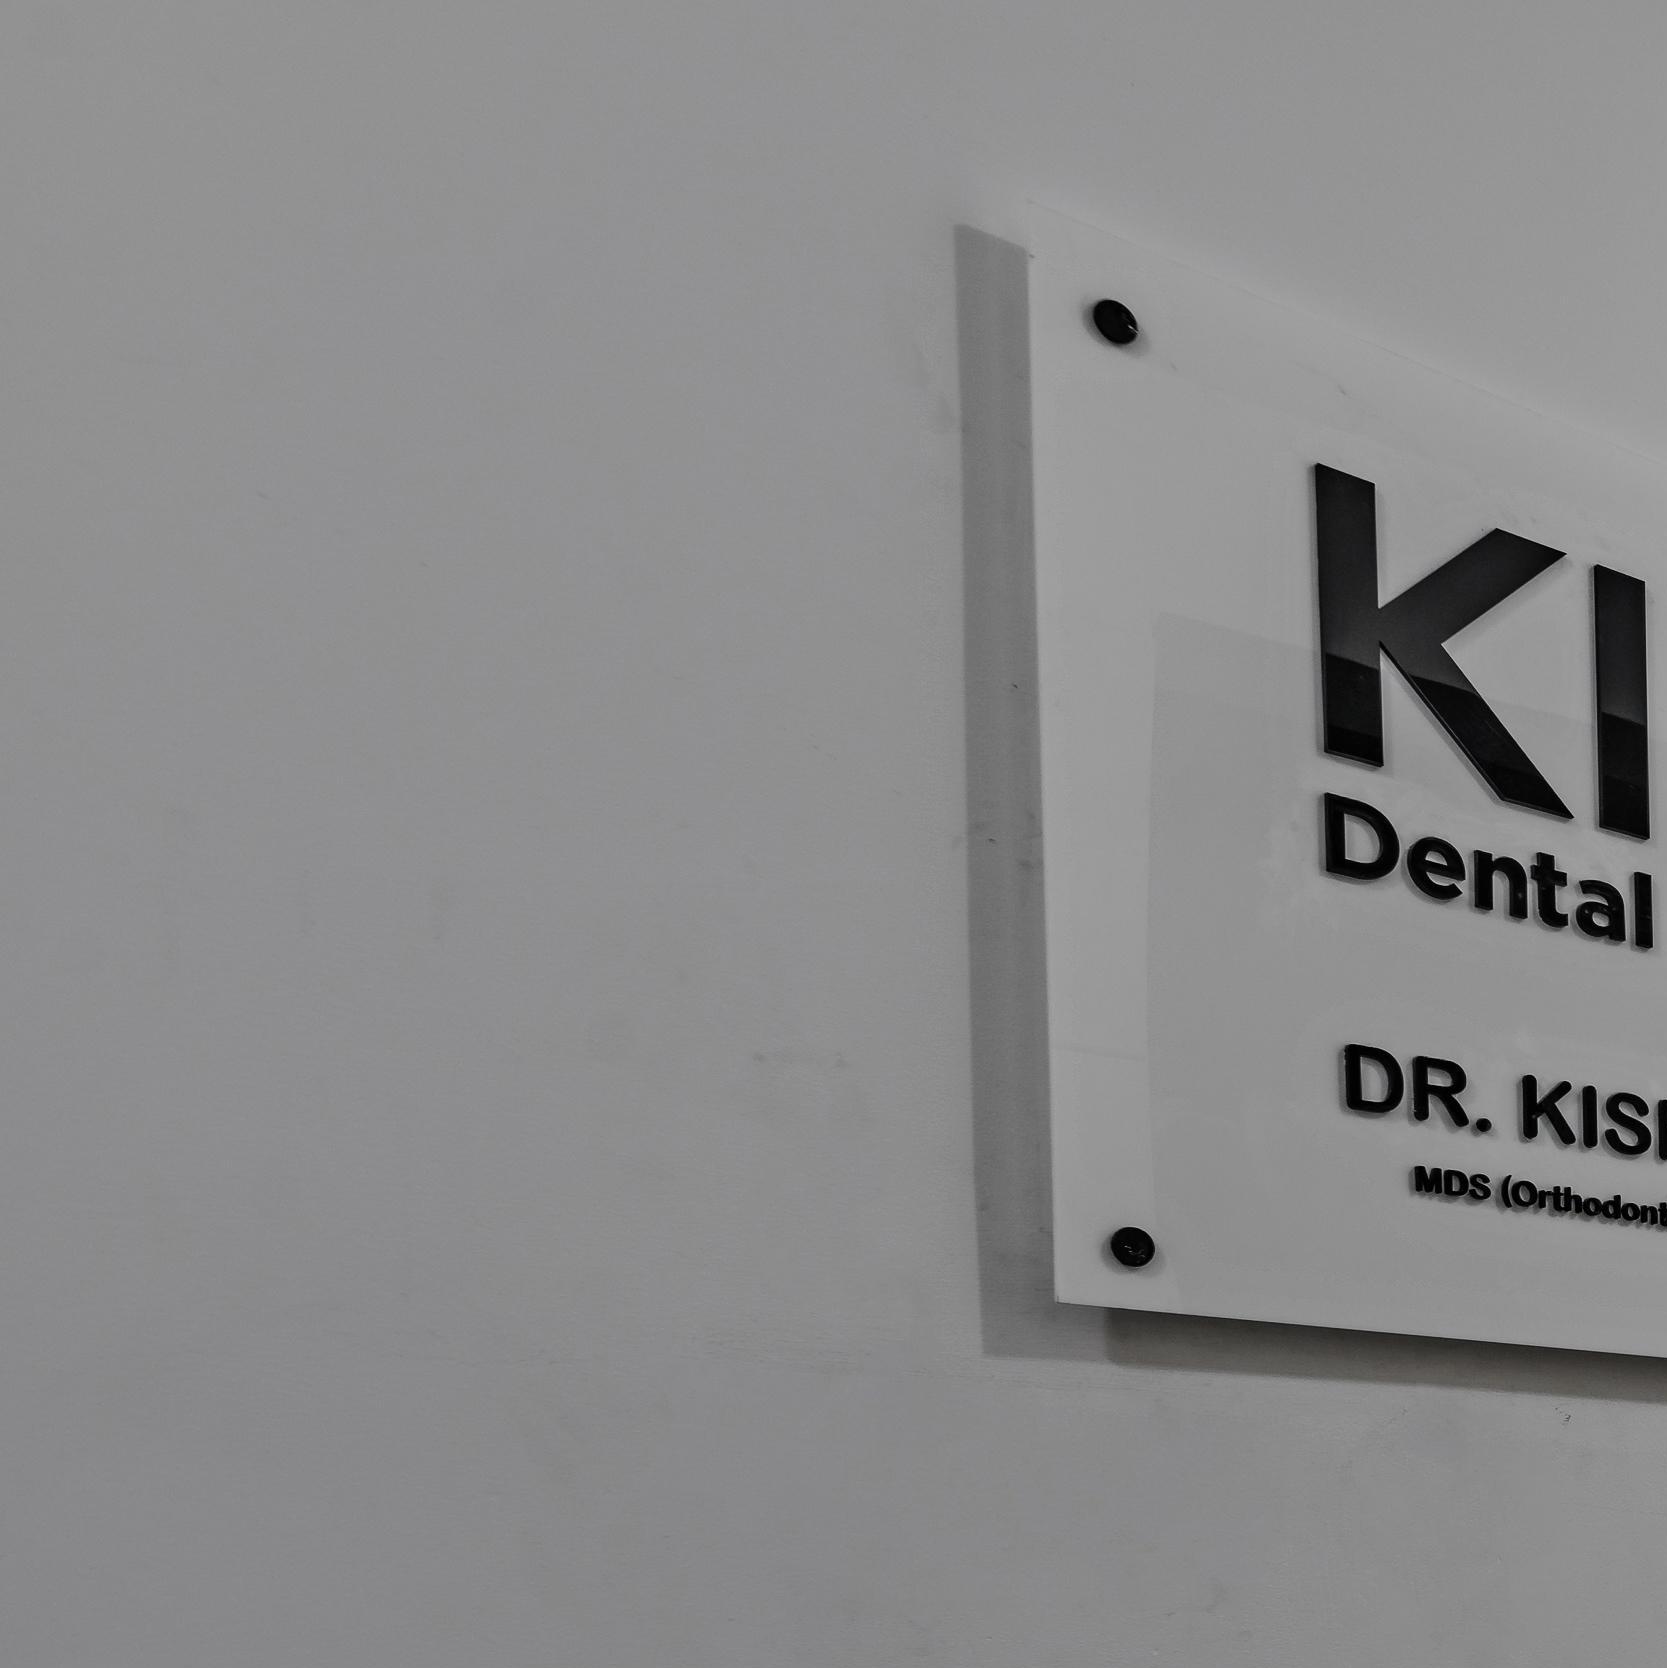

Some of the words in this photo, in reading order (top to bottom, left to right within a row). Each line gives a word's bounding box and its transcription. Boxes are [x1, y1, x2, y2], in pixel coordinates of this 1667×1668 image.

[1322, 792, 1653, 949] Dental
[1343, 1043, 1492, 1133] DR.
[1412, 1165, 1492, 1202] MDS
